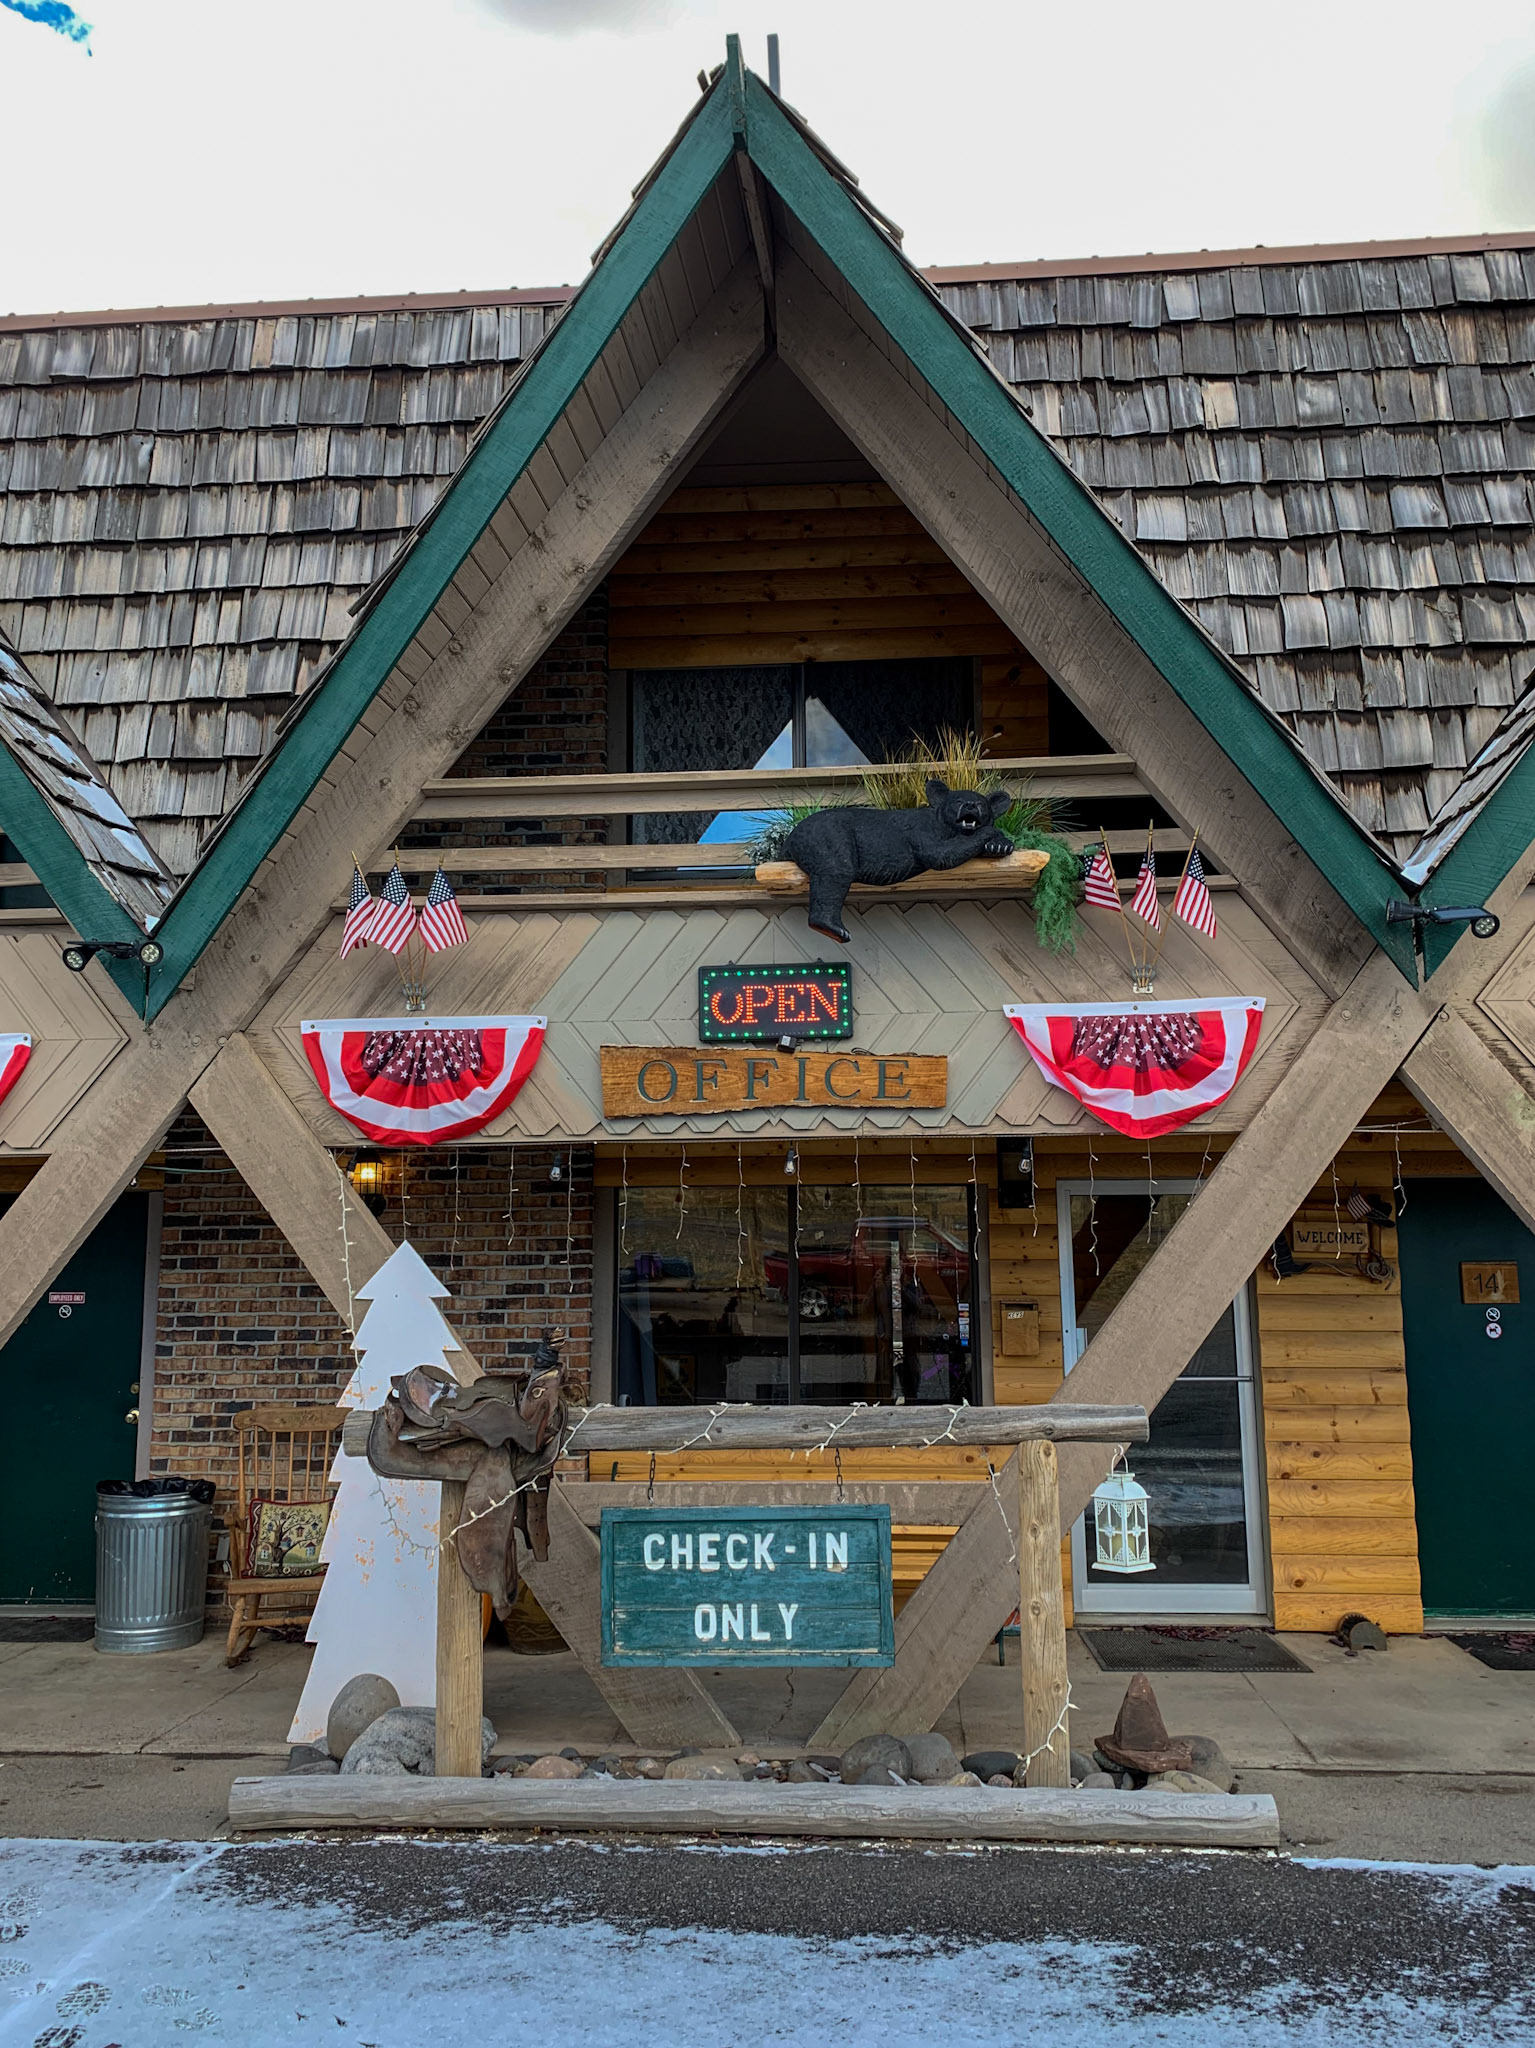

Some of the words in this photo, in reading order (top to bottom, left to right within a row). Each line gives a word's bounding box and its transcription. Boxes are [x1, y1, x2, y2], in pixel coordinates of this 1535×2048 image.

[710, 983, 842, 1024] OPEN
[636, 1057, 912, 1103] OFFICE
[1297, 1231, 1363, 1244] WELCOME
[1472, 1272, 1499, 1294] 14
[50, 1294, 73, 1302] EMPLOYEES
[73, 1294, 84, 1302] ONLY
[1008, 1311, 1024, 1319] KEYS
[643, 1531, 848, 1571] CHECK-IN
[694, 1603, 799, 1640] ONLY
